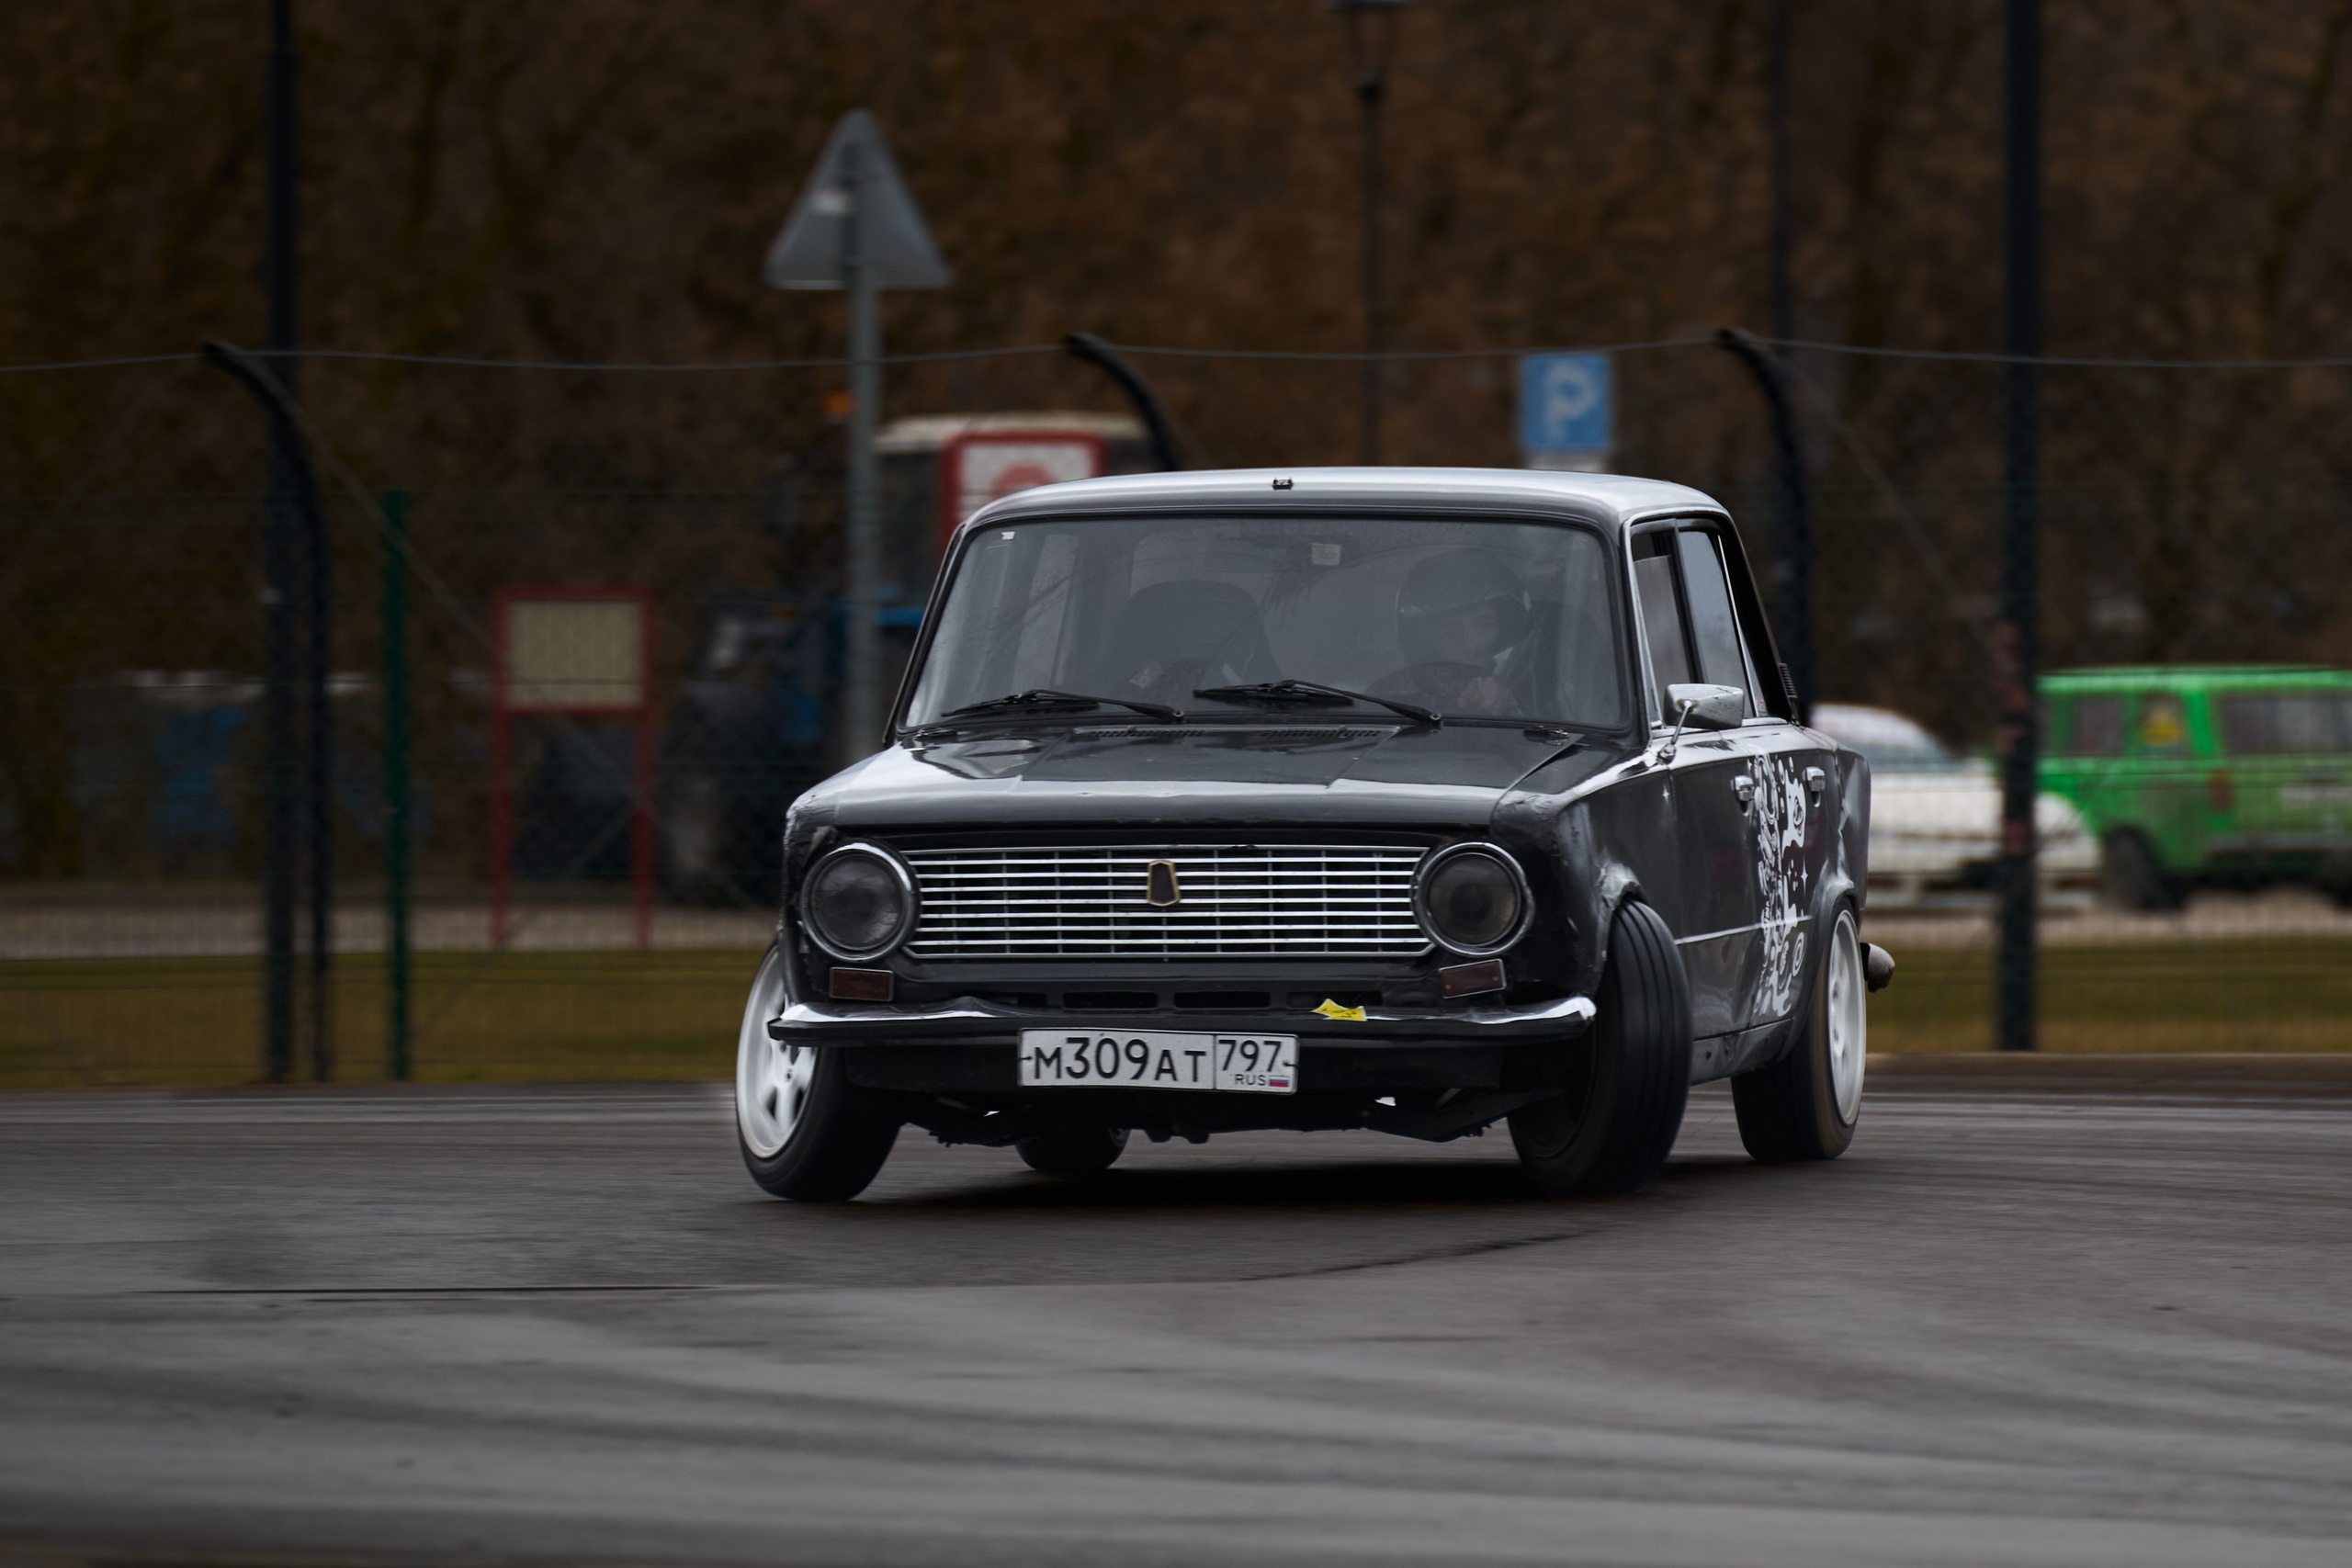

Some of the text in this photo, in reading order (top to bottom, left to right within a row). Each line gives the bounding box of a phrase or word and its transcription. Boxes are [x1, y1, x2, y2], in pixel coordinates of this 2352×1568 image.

[1544, 361, 1597, 439] P
[1217, 1039, 1282, 1072] 797
[1234, 1073, 1267, 1086] RUS
